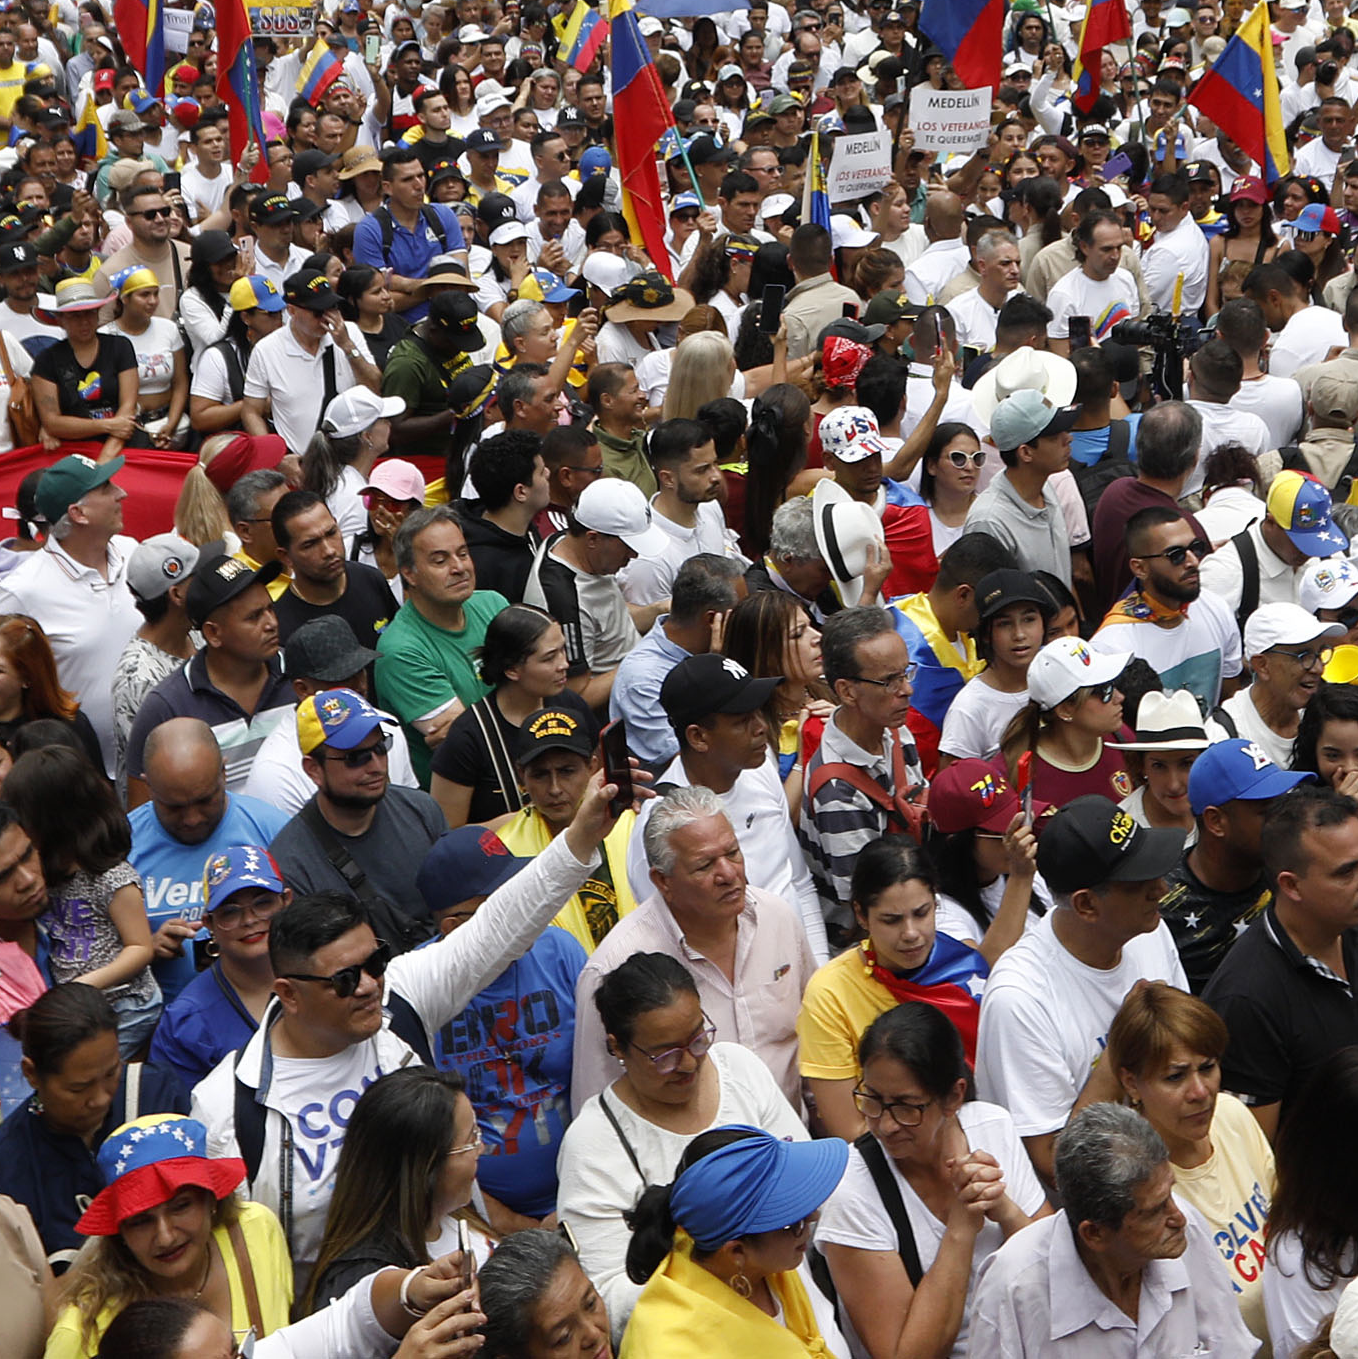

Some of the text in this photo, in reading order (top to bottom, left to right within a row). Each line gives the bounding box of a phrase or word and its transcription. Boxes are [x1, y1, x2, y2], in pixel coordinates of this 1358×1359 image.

[260, 8, 302, 33] SOS
[917, 122, 938, 131] LOS
[926, 135, 935, 143] TE
[547, 720, 558, 728] DE
[453, 1049, 491, 1065] THE
